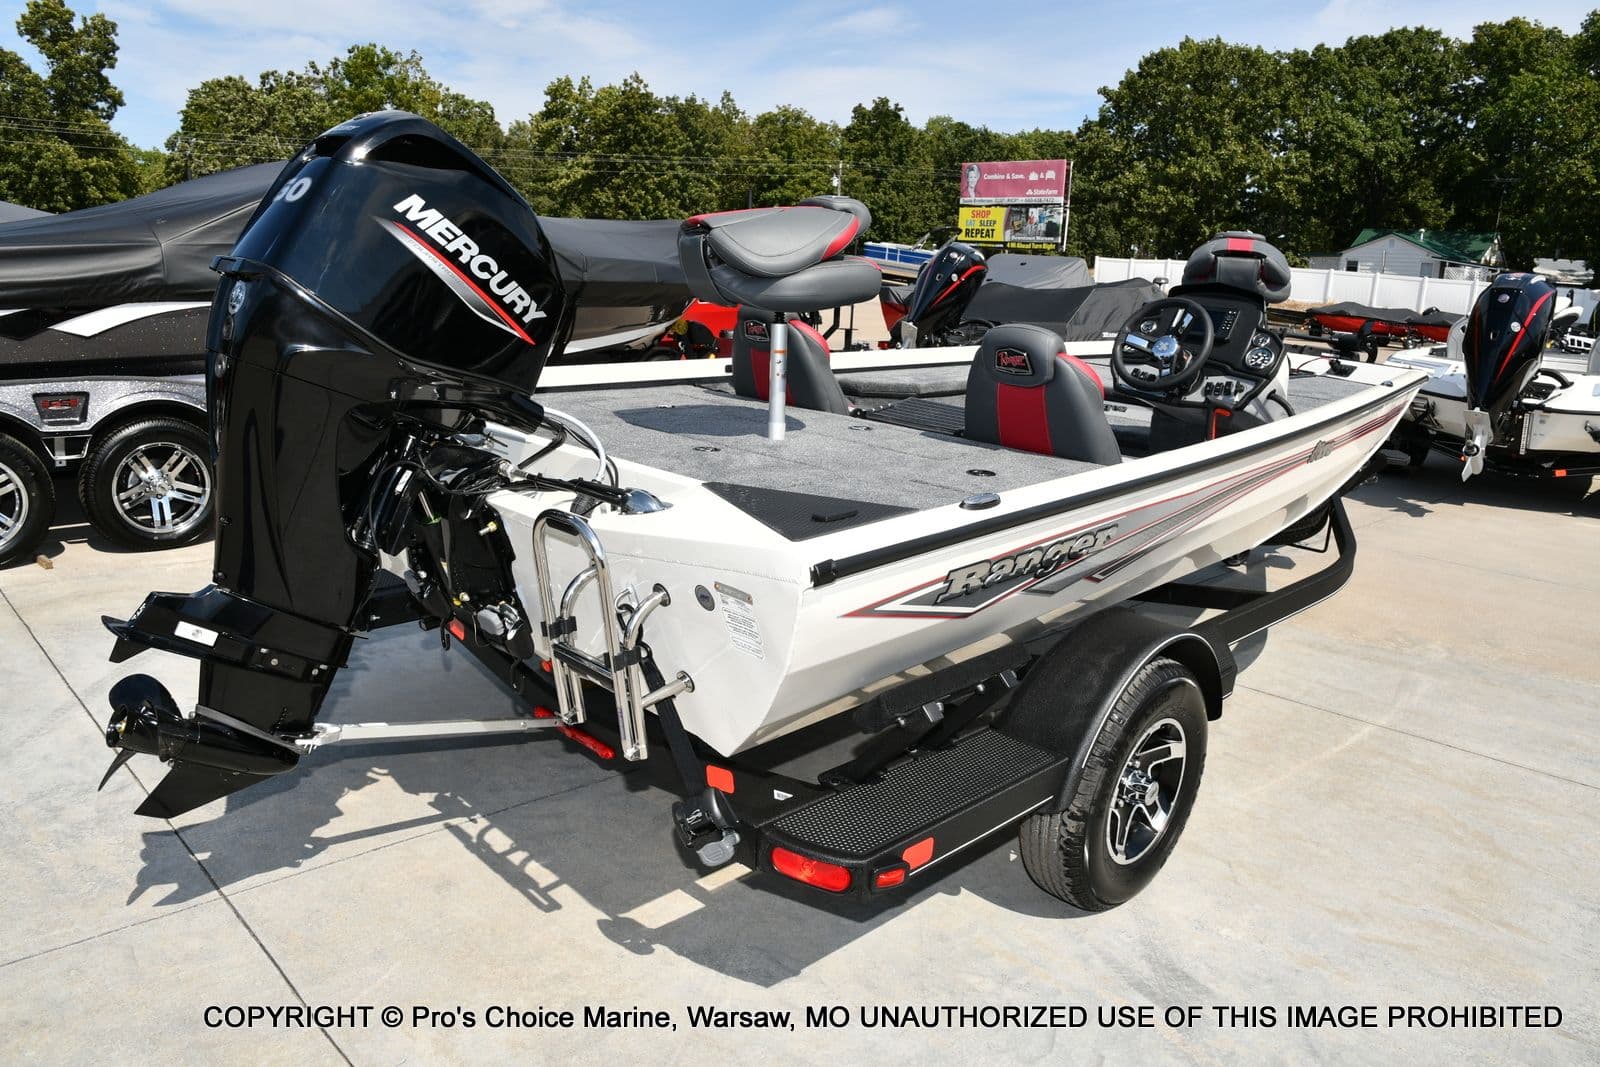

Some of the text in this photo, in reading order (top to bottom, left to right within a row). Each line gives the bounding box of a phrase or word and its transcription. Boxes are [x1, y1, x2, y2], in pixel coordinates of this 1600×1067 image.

[971, 209, 991, 219] SHOP
[966, 219, 997, 227] EAT SLEEP
[965, 228, 995, 239] REPEAT
[393, 193, 547, 324] MERCURY
[933, 524, 1119, 605] Ranger
